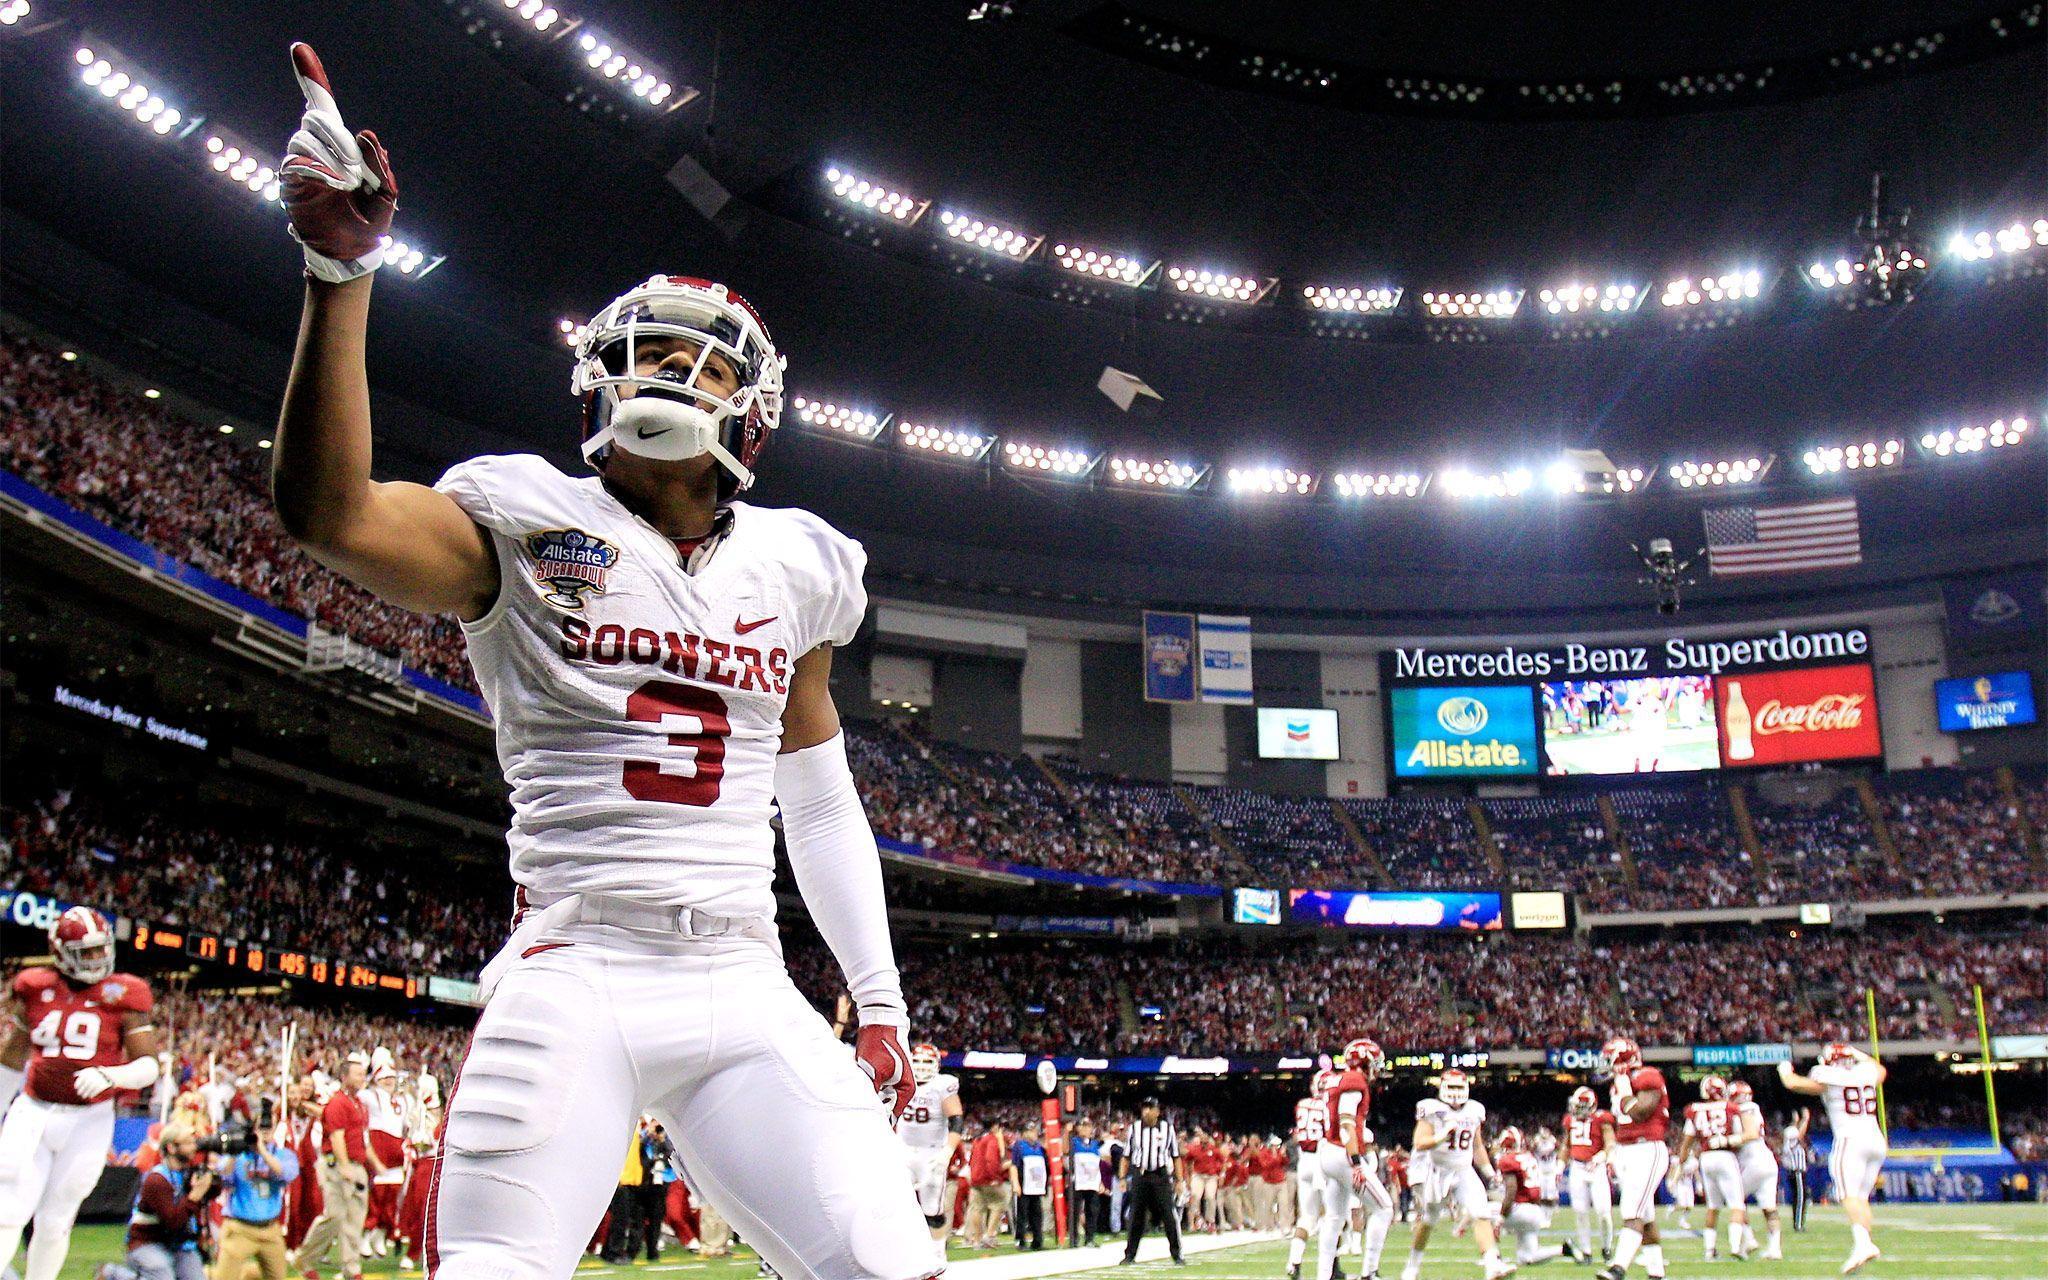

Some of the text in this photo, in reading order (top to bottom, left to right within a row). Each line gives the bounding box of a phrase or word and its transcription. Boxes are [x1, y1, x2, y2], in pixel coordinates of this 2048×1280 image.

[541, 544, 603, 566] Allstate
[560, 615, 787, 695] SOONERS
[1395, 629, 1868, 678] Mercedes-Benz Superdome
[622, 679, 732, 808] 3
[1407, 738, 1520, 767] Allstate
[31, 1010, 101, 1060] 49
[1570, 1119, 1593, 1147] 21
